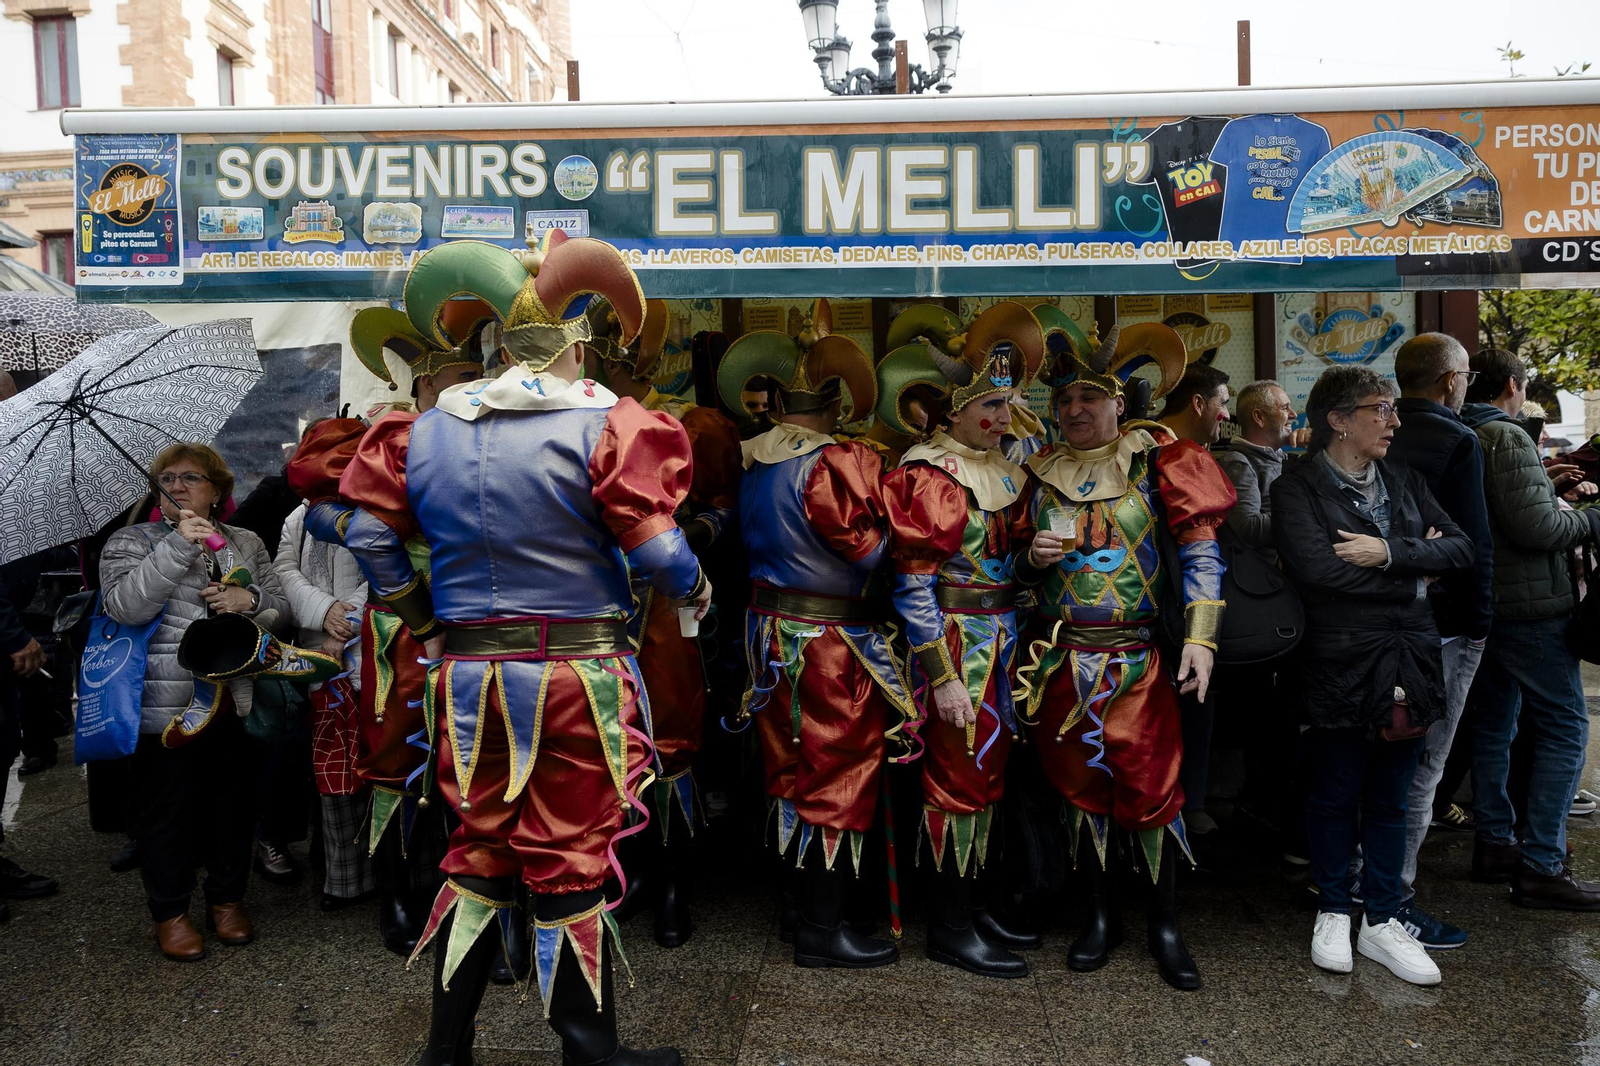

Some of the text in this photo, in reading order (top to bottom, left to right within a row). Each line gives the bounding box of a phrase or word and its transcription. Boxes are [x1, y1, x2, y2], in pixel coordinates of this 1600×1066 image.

[1255, 135, 1266, 147] Lo
[1188, 152, 1210, 162] PIXA
[1533, 153, 1569, 178] TU
[217, 144, 547, 199] SOUVENIRS
[1167, 162, 1213, 191] TOY
[1261, 167, 1298, 179] MUNDO
[94, 177, 161, 213] El Melli
[1180, 184, 1216, 201] en CAI
[538, 218, 577, 229] CÁDIZ
[1524, 209, 1600, 233] CARN
[103, 230, 154, 239] Se personalizan
[100, 240, 118, 249] pitos
[651, 249, 738, 266] LLAVEROS,
[742, 248, 838, 265] CAMISETAS,
[842, 247, 922, 264] DEDALES,
[926, 247, 968, 263] PINS,
[972, 246, 1042, 262] CHAPAS,
[1047, 244, 1139, 261] PULSERAS,
[1144, 242, 1237, 260] COLLARES,
[1241, 239, 1335, 258] AZULEJOS,
[1340, 239, 1407, 255] PLACAS
[1412, 235, 1512, 254] METÁLICAS
[201, 252, 235, 268] ART.
[239, 252, 257, 267] DE
[262, 252, 341, 267] REGALOS:
[345, 251, 408, 268] IMANES,
[1170, 317, 1199, 327] USICA
[1328, 313, 1361, 329] CARNAVAL
[1313, 320, 1383, 354] El Melli
[1336, 345, 1368, 359] CARNAVAL
[1220, 421, 1244, 439] REGAL
